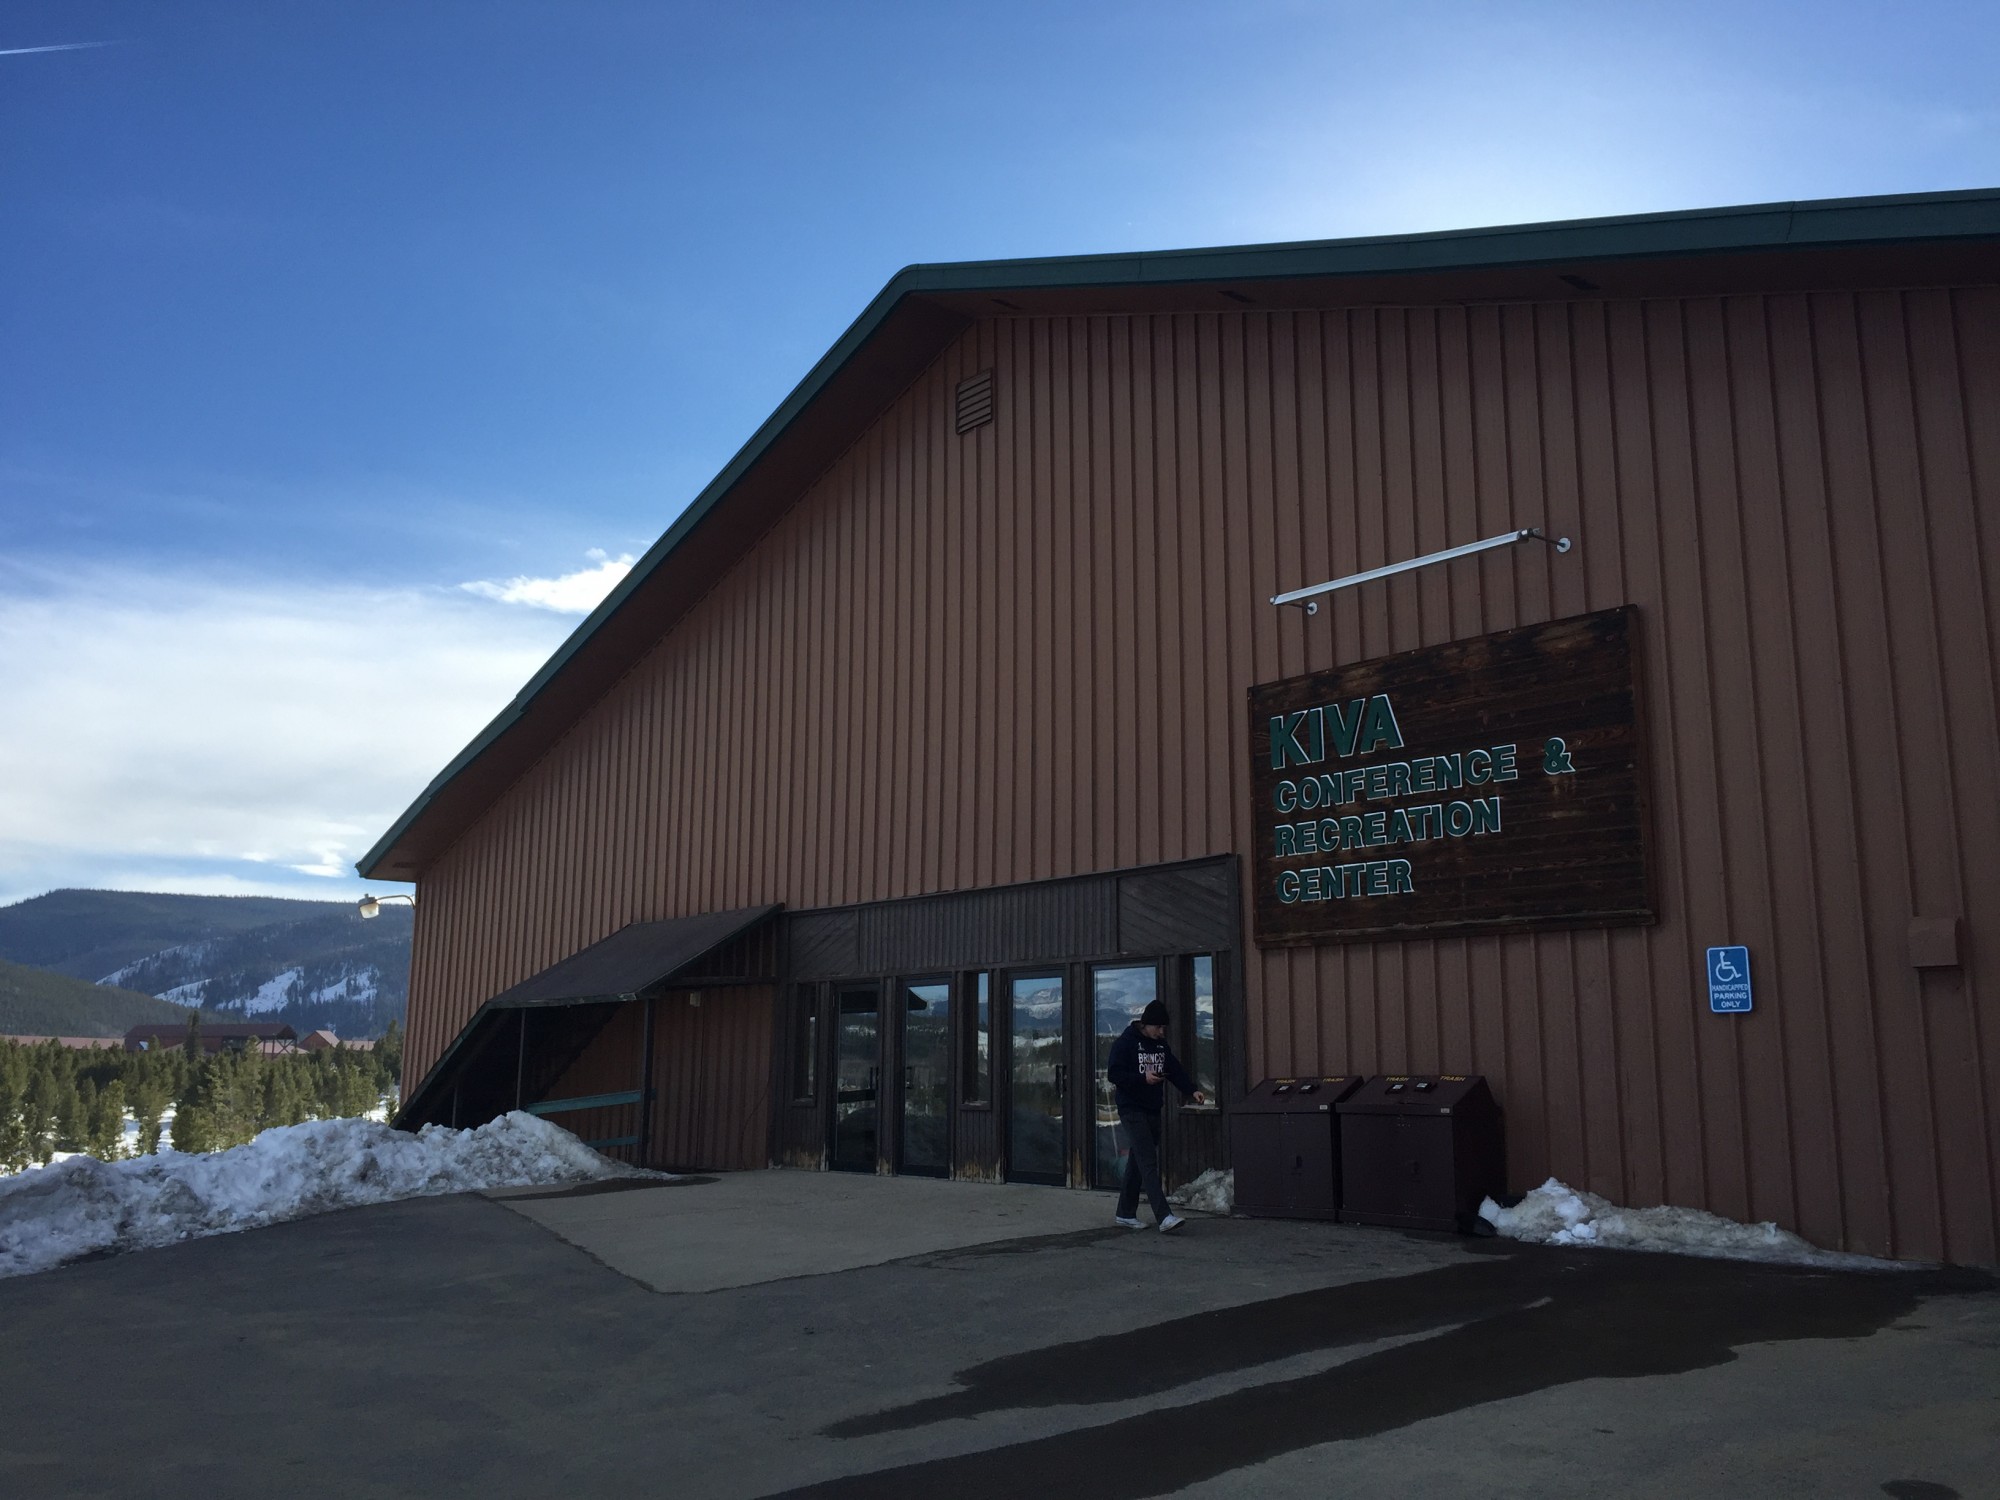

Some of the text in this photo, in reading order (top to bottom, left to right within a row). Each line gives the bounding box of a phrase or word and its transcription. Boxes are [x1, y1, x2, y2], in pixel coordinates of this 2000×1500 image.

[1270, 693, 1404, 769] KIVA
[1275, 737, 1575, 813] CONFERENCE &
[1275, 797, 1501, 857] RECREATION
[1276, 858, 1414, 903] CENTER
